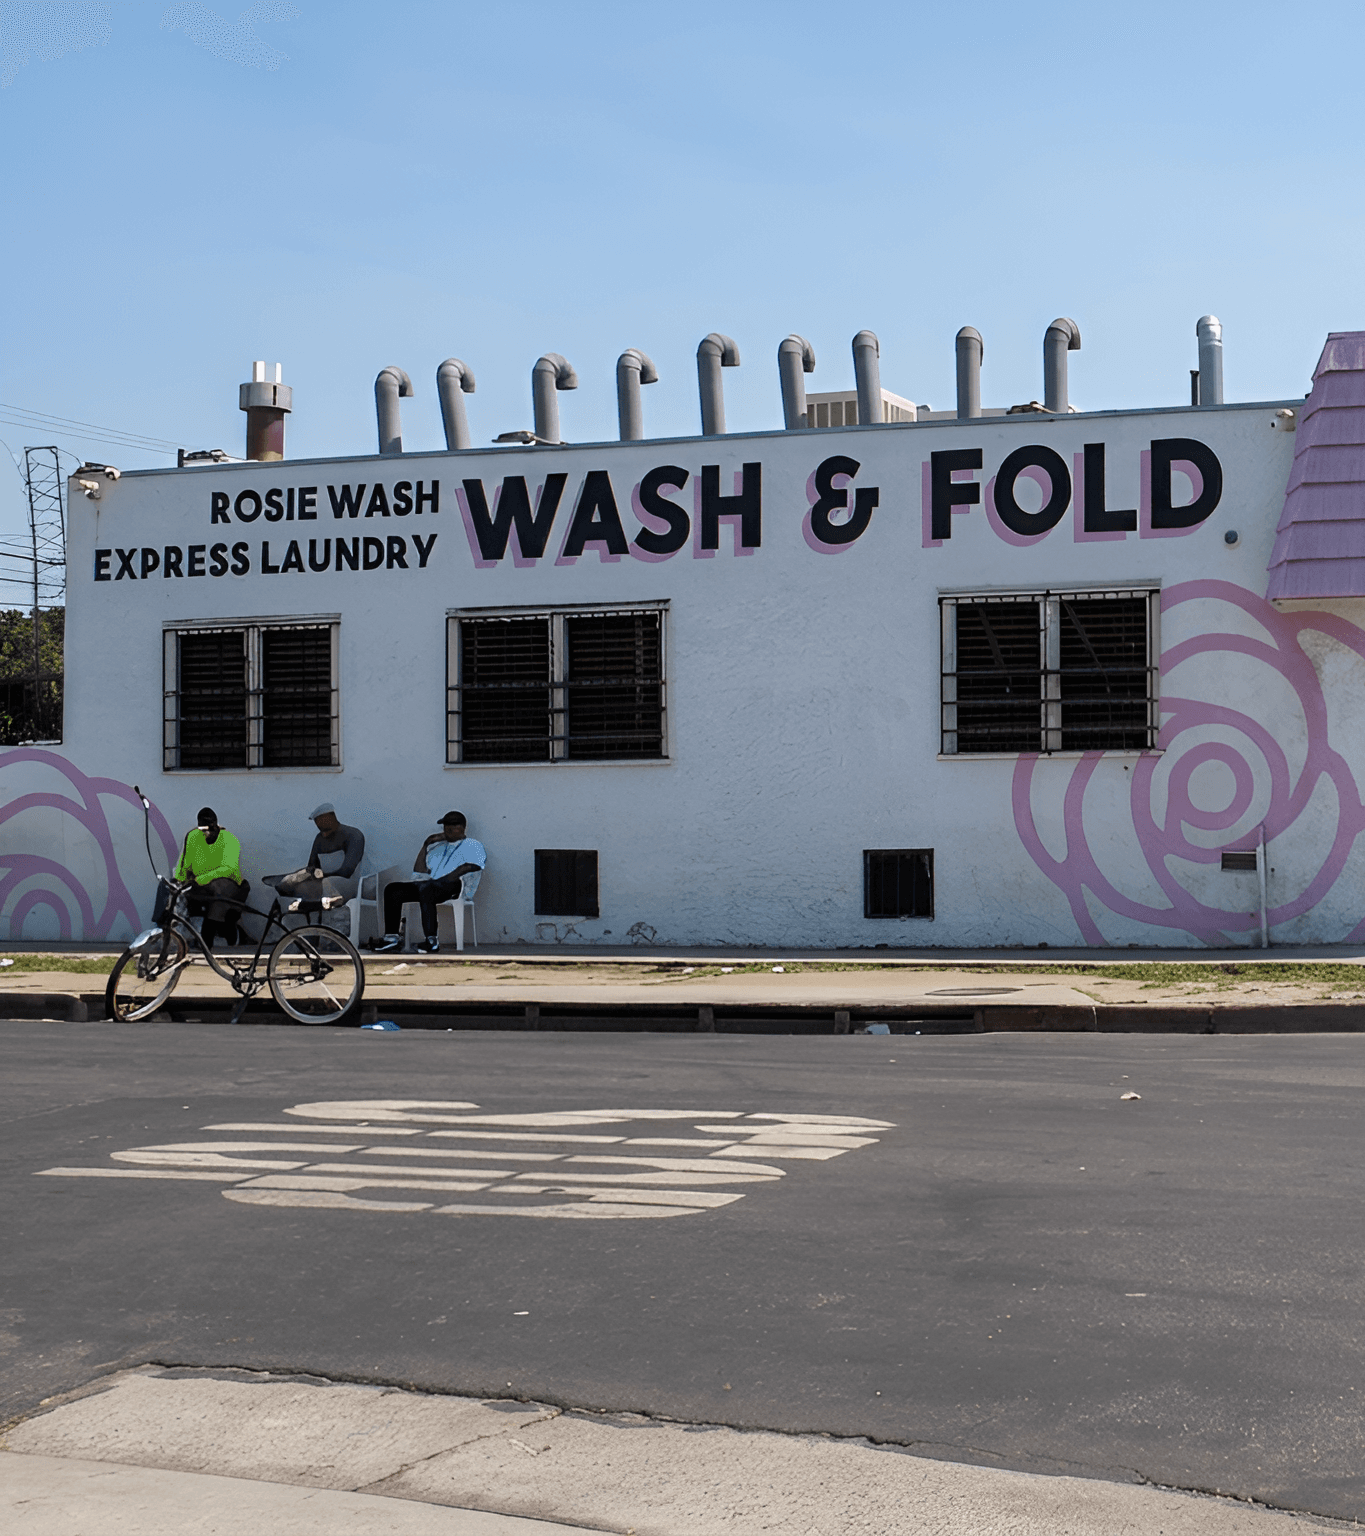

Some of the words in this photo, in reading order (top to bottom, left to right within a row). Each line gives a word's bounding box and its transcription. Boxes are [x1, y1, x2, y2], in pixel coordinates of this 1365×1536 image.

[211, 487, 318, 525] ROSIE
[327, 480, 440, 519] WASH
[462, 461, 762, 561] WASH
[810, 455, 880, 545] &
[930, 437, 1223, 541] FOLD
[94, 542, 250, 582] EXPRESS
[262, 534, 438, 575] LAUNDRY
[36, 1100, 897, 1219] STOP
